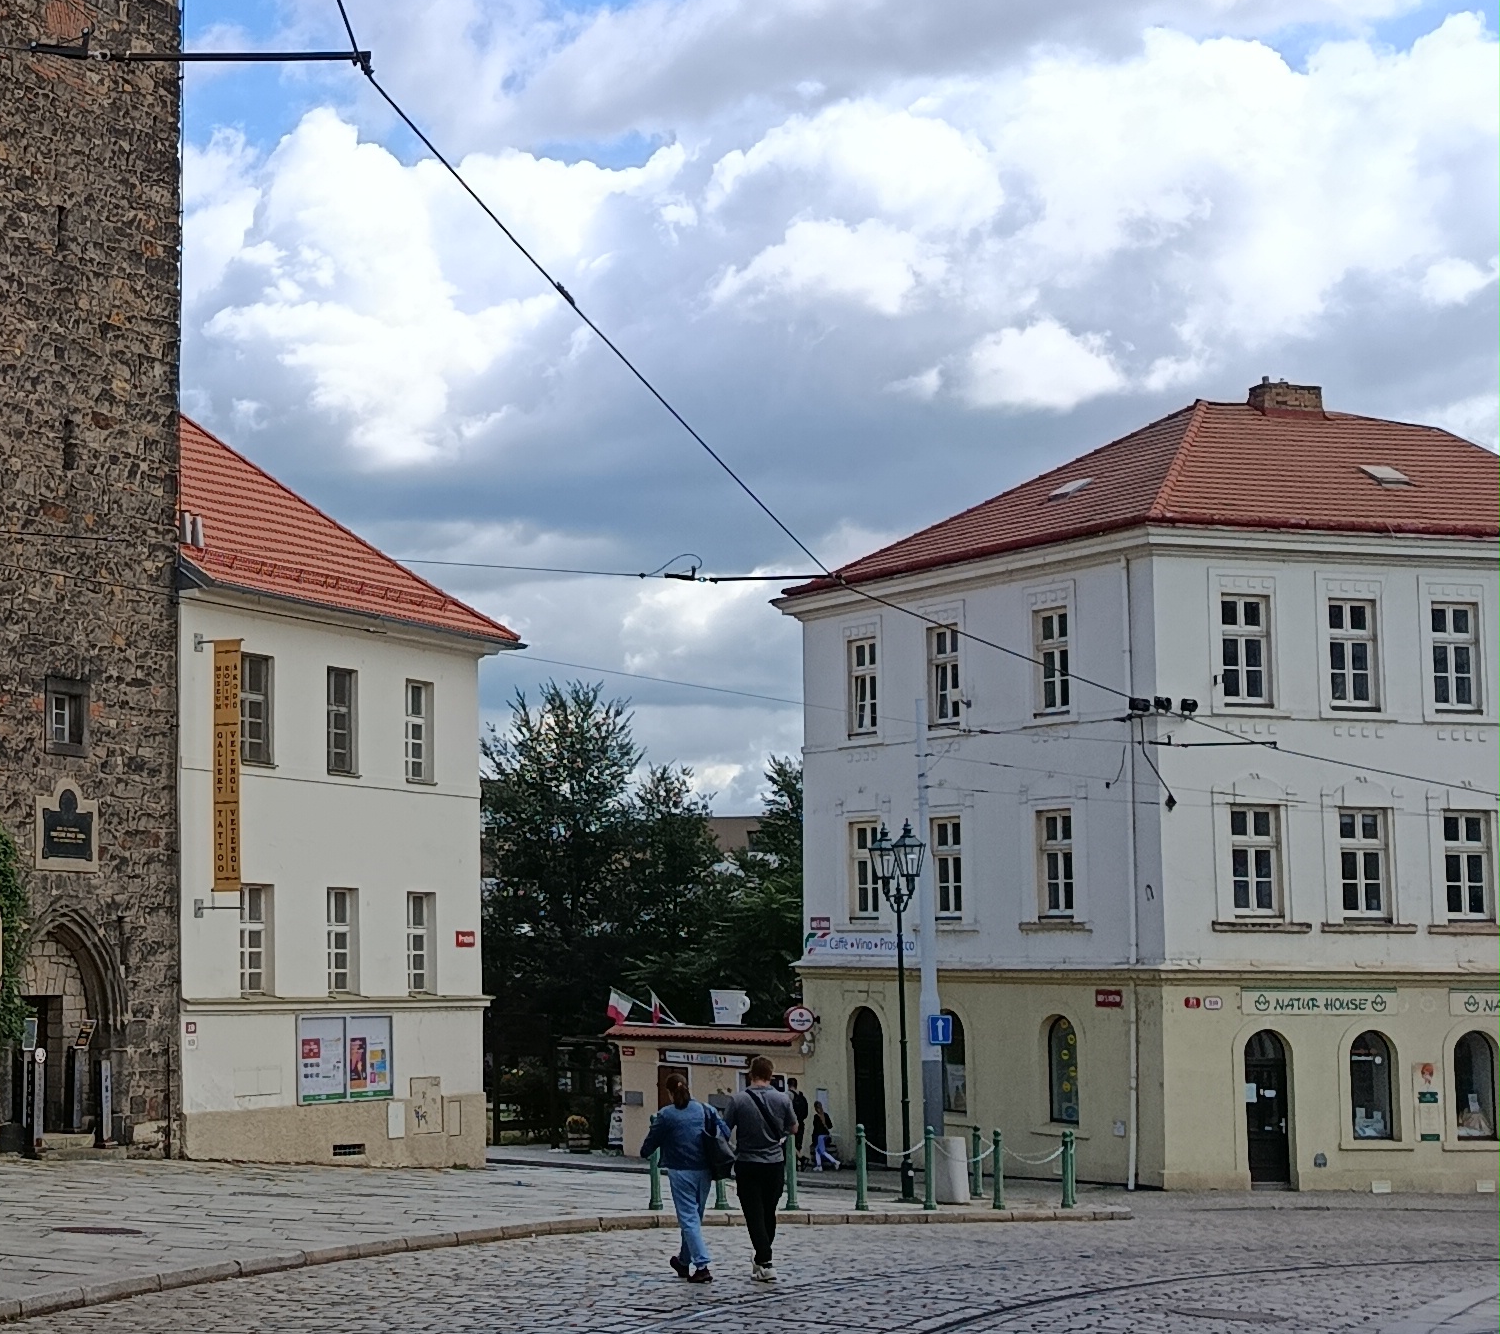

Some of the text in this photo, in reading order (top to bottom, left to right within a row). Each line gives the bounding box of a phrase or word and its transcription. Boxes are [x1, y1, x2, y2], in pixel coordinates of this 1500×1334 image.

[216, 809, 225, 873] TATTOO
[855, 938, 873, 951] Vino
[1273, 997, 1369, 1012] NATUR HOUSE
